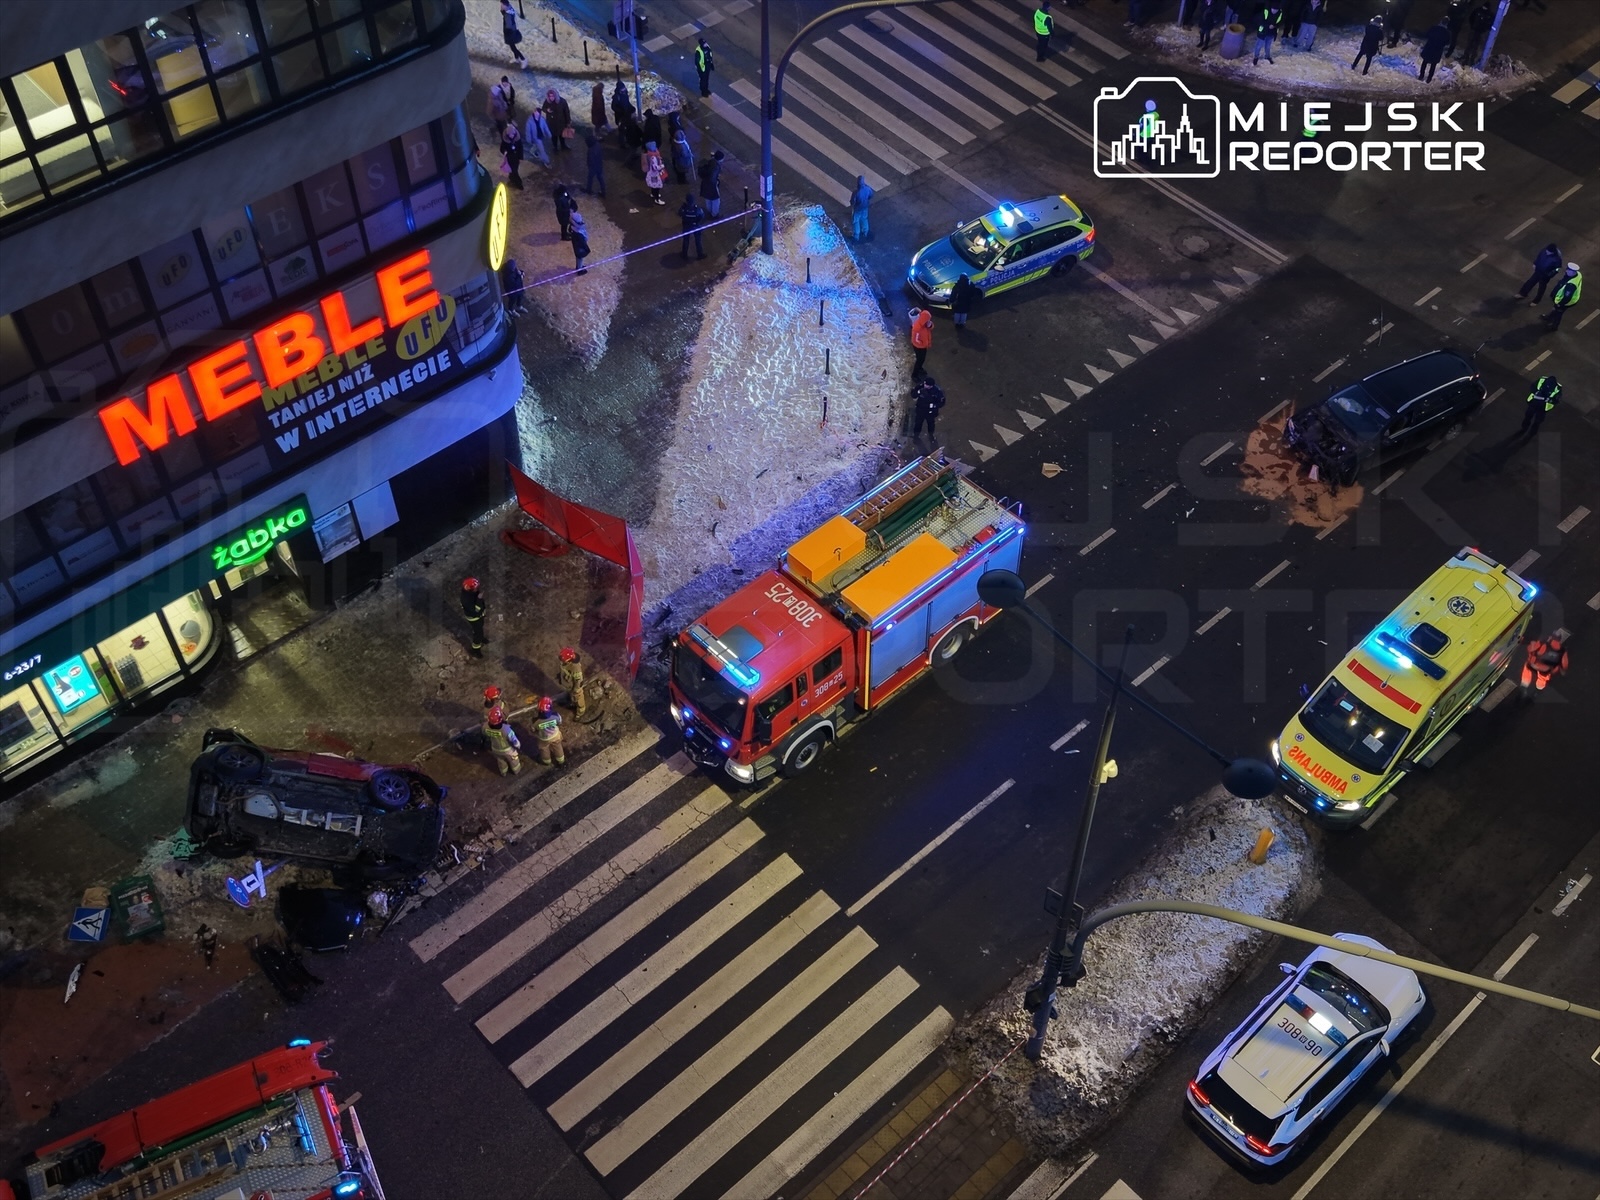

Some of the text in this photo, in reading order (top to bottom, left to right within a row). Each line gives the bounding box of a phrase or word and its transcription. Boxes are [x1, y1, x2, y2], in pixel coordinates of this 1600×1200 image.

[161, 254, 188, 287] UFO
[217, 228, 243, 261] UFO
[989, 271, 1016, 285] POLICJA
[403, 298, 449, 356] UFO
[98, 249, 440, 467] MEBLE
[261, 336, 387, 413] MEBLE
[267, 363, 376, 429] TANIEJ NIŻ
[274, 348, 452, 455] W INTERNECIE
[210, 506, 308, 571] żabka
[3, 654, 43, 682] 6-23/7
